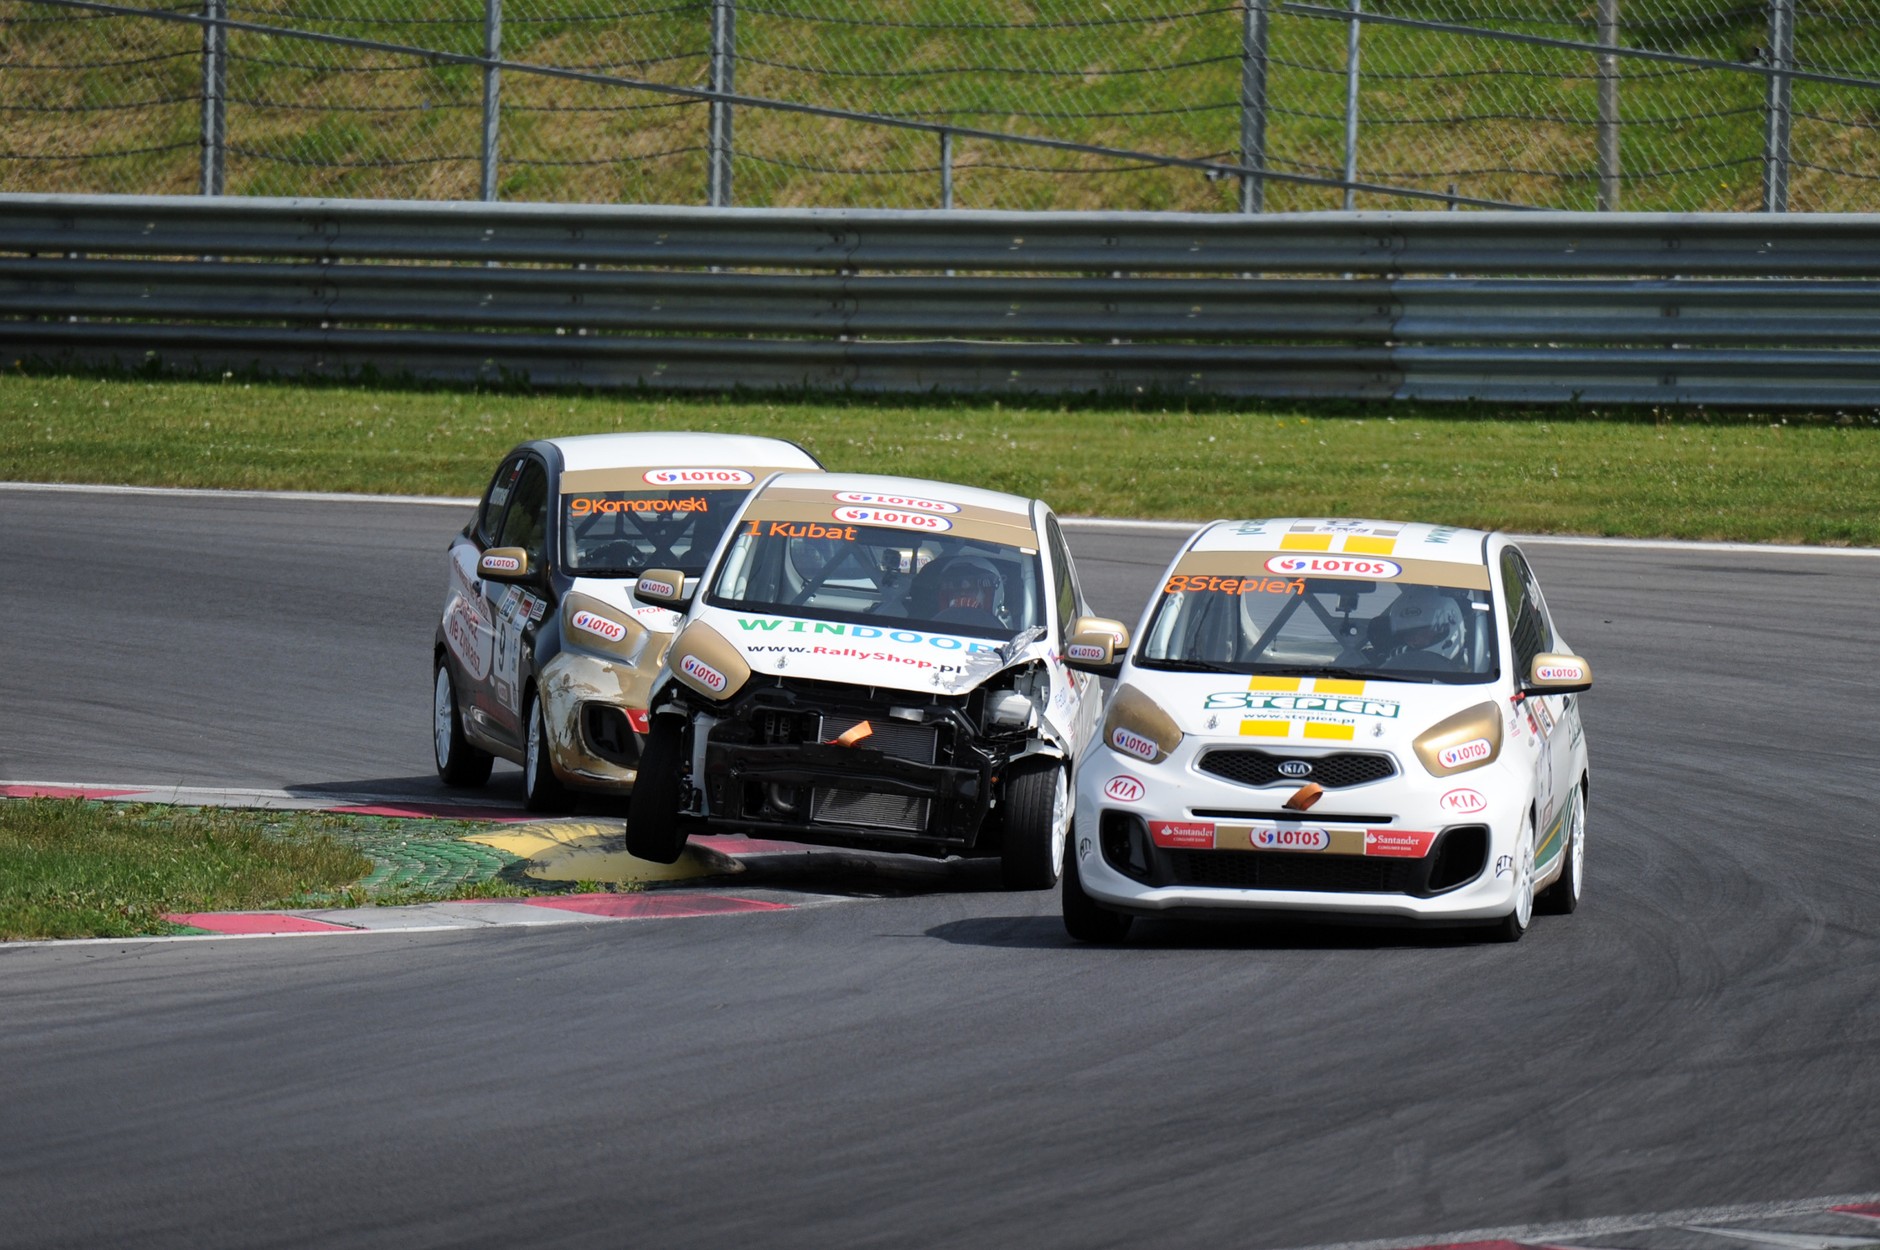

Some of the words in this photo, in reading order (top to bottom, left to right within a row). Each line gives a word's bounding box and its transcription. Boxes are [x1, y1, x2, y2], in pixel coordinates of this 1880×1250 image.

[681, 471, 741, 482] LOTOS
[877, 496, 945, 510] LOTOS
[873, 511, 938, 528] LOTOS
[746, 520, 761, 536] 1
[769, 522, 857, 541] Kubat
[492, 560, 516, 568] LOTOS
[1311, 559, 1385, 574] LOTOS
[648, 583, 670, 594] LOTOS
[588, 617, 620, 637] LOTOS
[747, 645, 962, 674] www.RallyShop.pl
[1078, 650, 1101, 658] LOTOS
[693, 664, 721, 688] LOTOS
[1552, 667, 1578, 678] LOTOS
[1125, 736, 1153, 756] LOTOS
[1457, 744, 1487, 760] LOTOS
[1283, 763, 1306, 774] KIA
[1109, 779, 1138, 799] KIA
[1449, 796, 1481, 808] KIA
[1172, 826, 1213, 837] Santander
[1276, 832, 1320, 846] LOTOS
[1377, 834, 1420, 845] Santander
